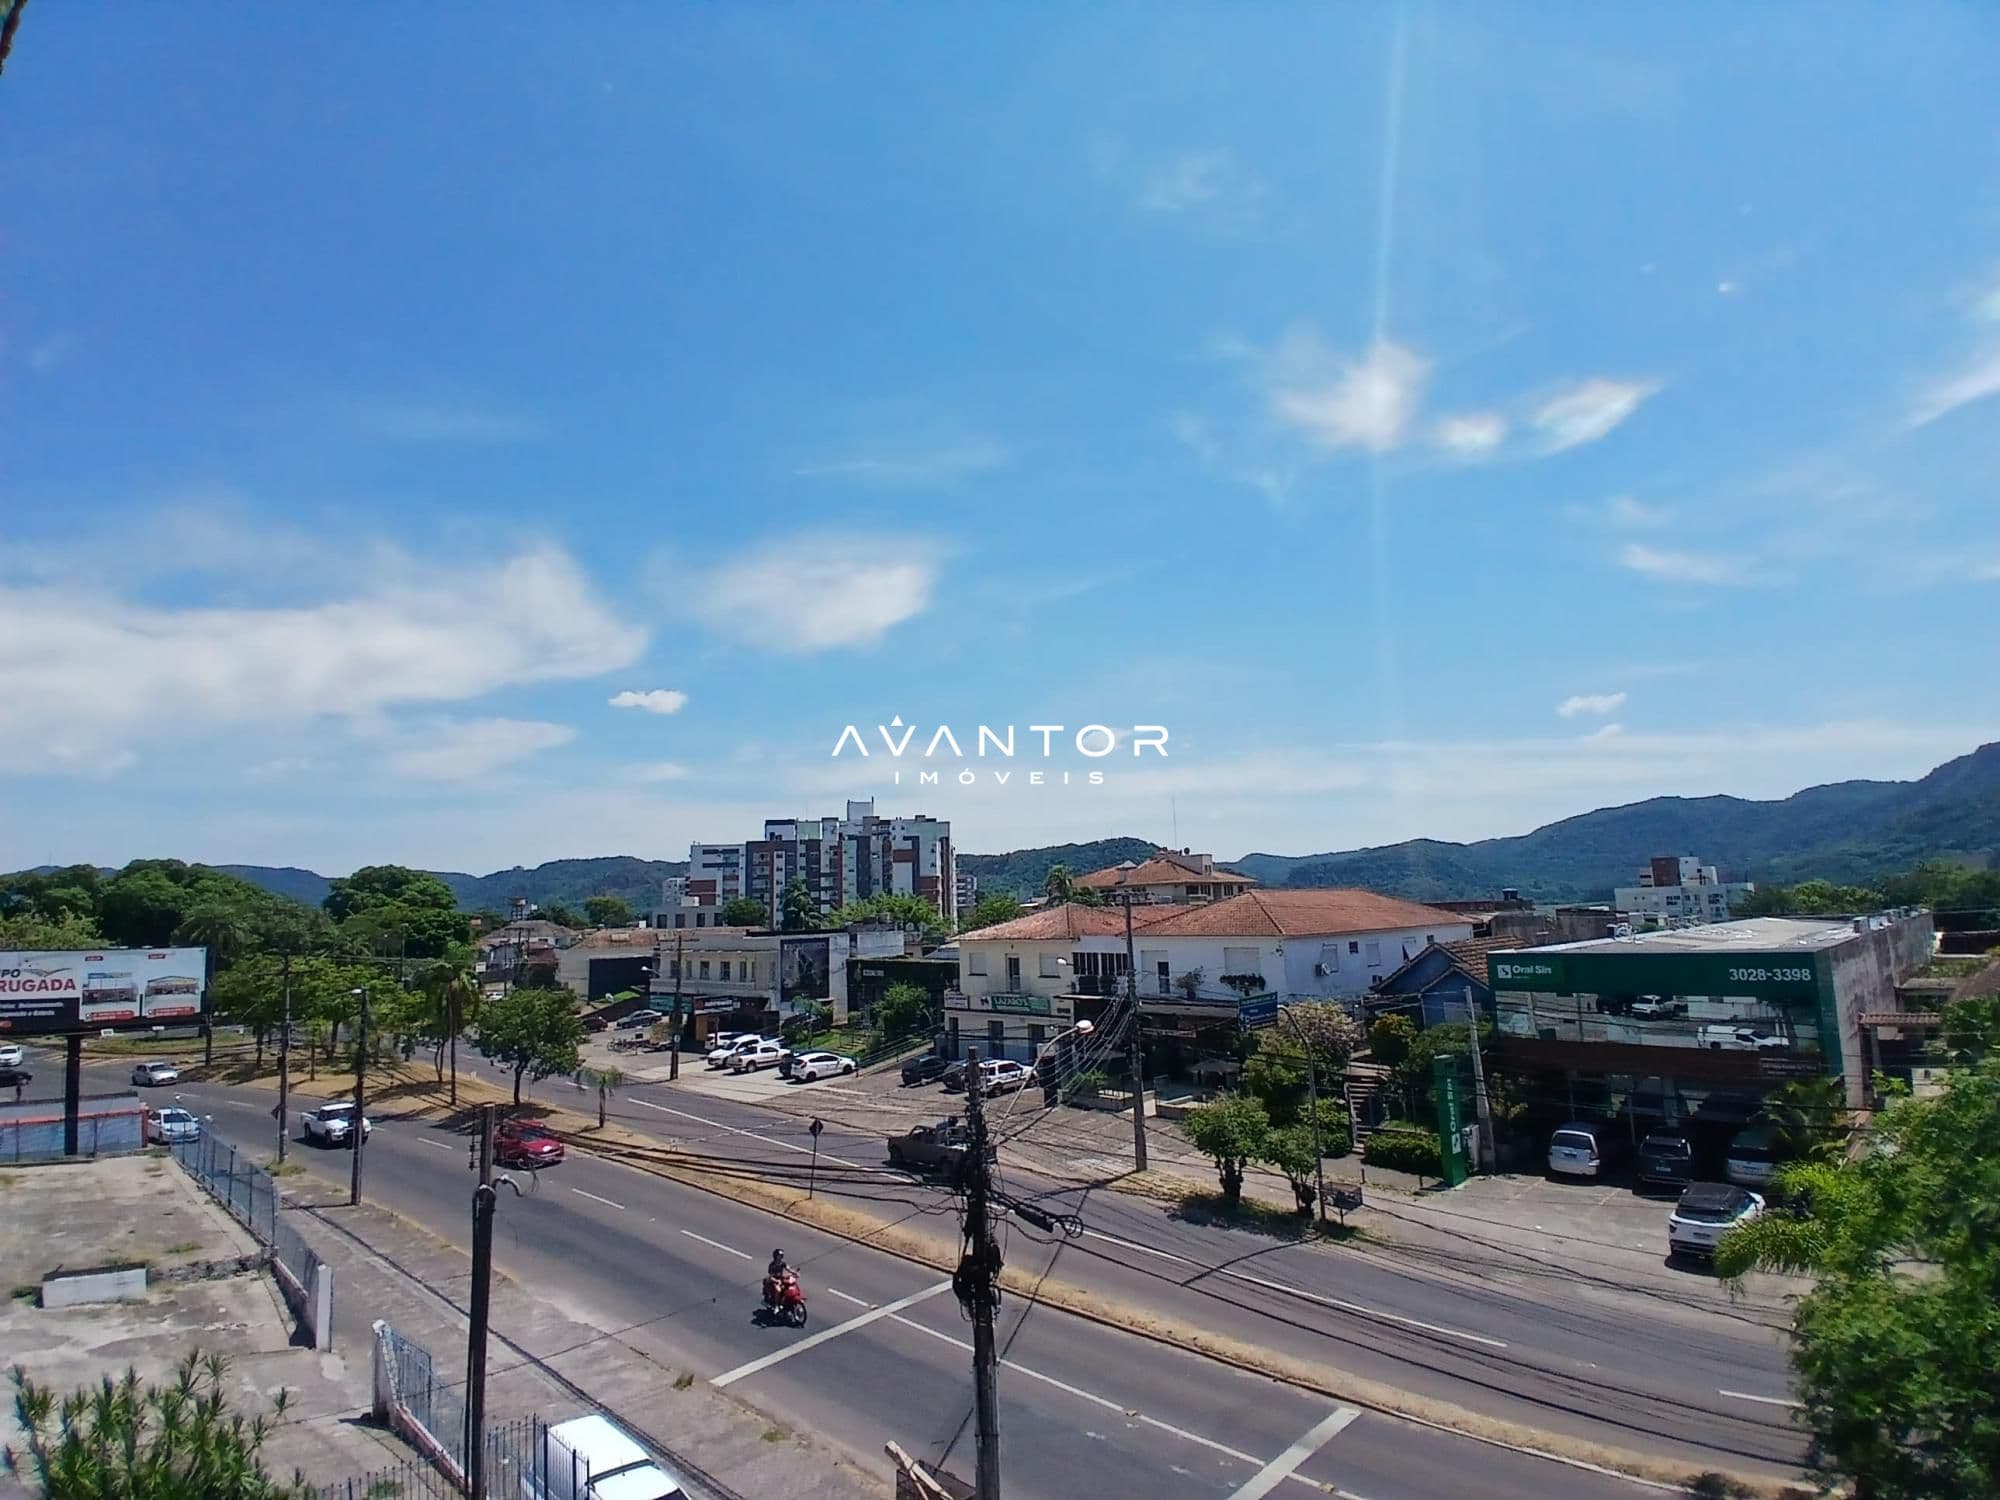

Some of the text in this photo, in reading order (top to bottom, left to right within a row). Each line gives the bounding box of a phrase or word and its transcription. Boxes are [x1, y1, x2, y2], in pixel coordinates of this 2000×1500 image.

[1512, 964, 1552, 974] Oral Sin
[1728, 968, 1812, 981] 3028-3398
